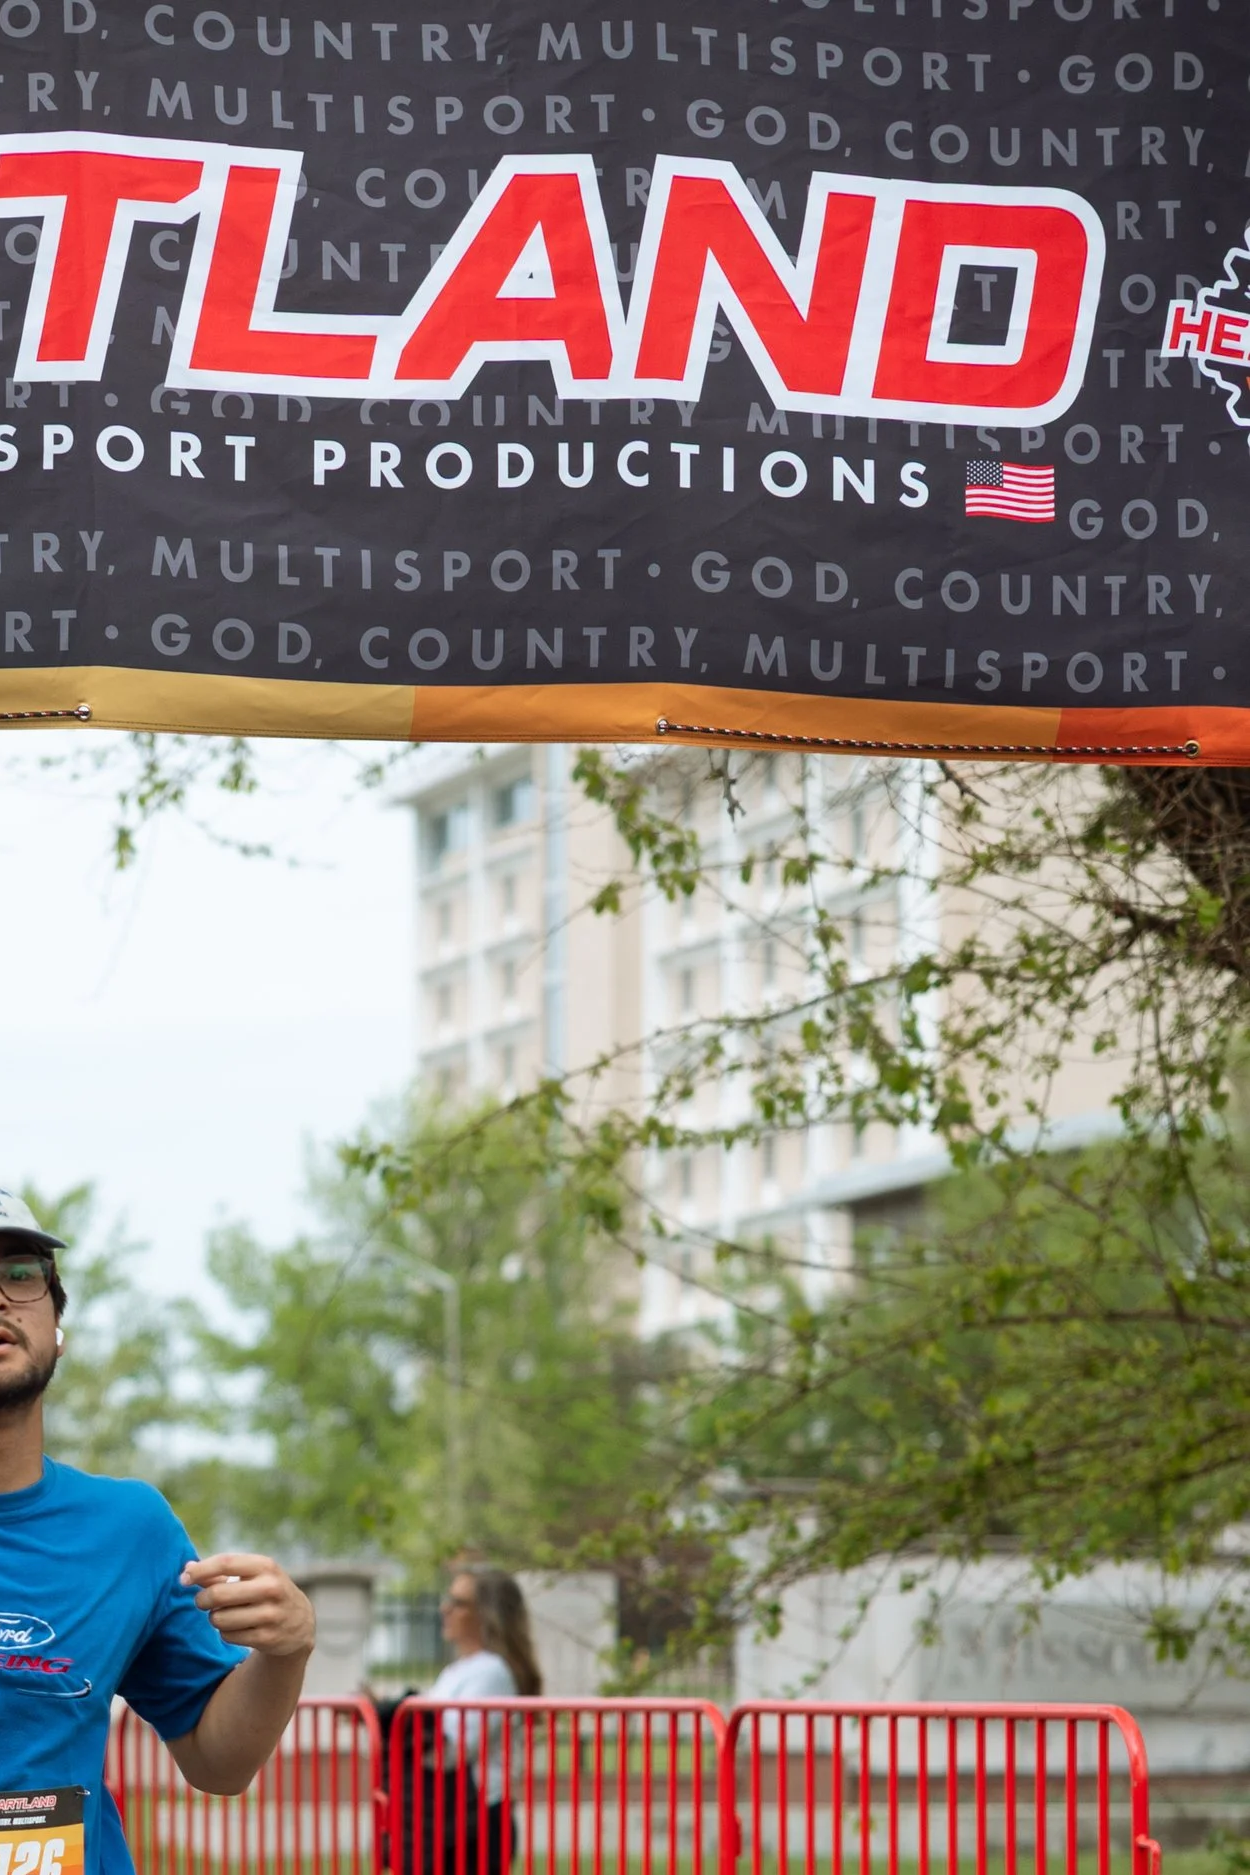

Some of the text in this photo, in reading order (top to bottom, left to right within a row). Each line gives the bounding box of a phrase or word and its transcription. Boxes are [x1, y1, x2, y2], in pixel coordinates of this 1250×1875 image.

[144, 4, 503, 65] COUNTRY,
[537, 20, 991, 92] MULTISPORT
[1059, 53, 1214, 99] GOD,
[146, 77, 615, 136] MULTISPORT
[687, 99, 851, 157] GOD,
[885, 121, 1214, 173] COUNTRY,
[1167, 306, 1250, 362] HE
[312, 438, 931, 508] PRODUCTIONS
[1069, 498, 1219, 542] GOD,
[151, 535, 621, 592] MULTISPORT
[691, 551, 858, 608] GOD,
[895, 568, 1222, 617] COUNTRY,
[151, 613, 322, 668] GOD,
[360, 626, 707, 672] COUNTRY,
[744, 634, 1187, 692] MULTISPORT
